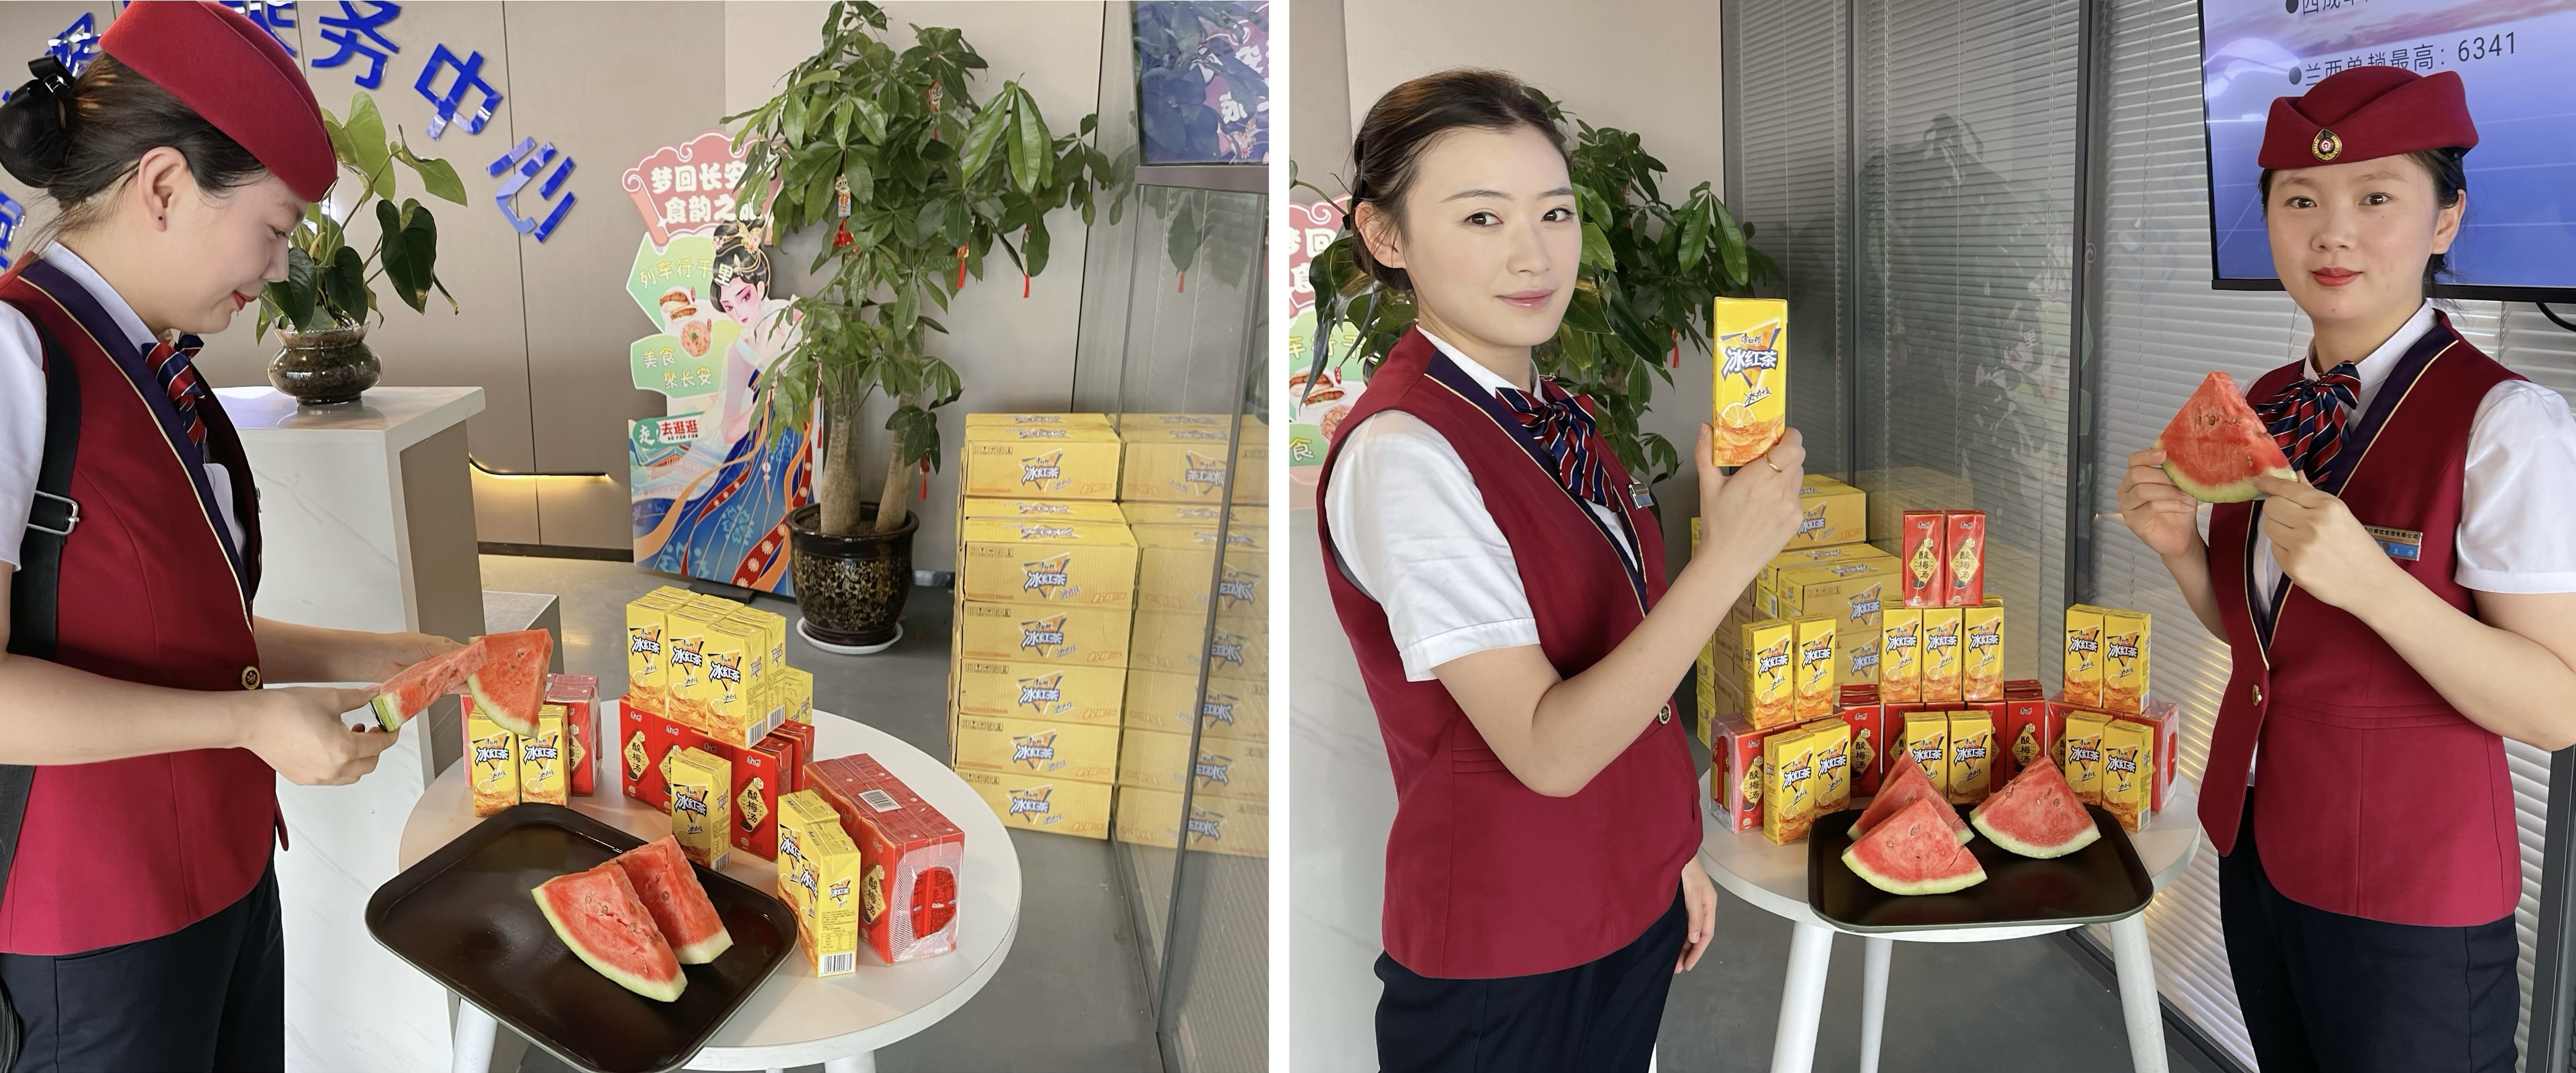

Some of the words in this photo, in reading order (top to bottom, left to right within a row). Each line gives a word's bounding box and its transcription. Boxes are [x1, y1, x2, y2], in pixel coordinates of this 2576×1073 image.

[651, 160, 748, 194] 梦回长安
[643, 346, 676, 369] 美食
[1722, 347, 1777, 380] 冰红茶
[663, 366, 713, 389] 聚长安
[661, 419, 698, 436] 去逛逛
[2364, 527, 2418, 540] 行餐饮管理有限公司
[1918, 551, 1929, 579] 酸梅汤
[631, 635, 661, 655] 冰红茶
[1886, 635, 1918, 655] 冰红茶
[1927, 635, 1958, 654] 冰红茶
[1968, 634, 2000, 654] 冰红茶
[2068, 636, 2098, 656] 冰红茶
[2107, 642, 2138, 662] 冰红茶
[671, 646, 703, 668] 冰红茶
[1758, 654, 1789, 679] 冰红茶
[1802, 647, 1832, 676] 冰红茶
[709, 661, 741, 684] 冰红茶
[475, 747, 510, 767] 冰红茶
[523, 745, 558, 765] 冰红茶
[632, 742, 642, 773] 酸梅汤
[1855, 741, 1867, 769] 酸梅汤
[1913, 748, 1943, 764] 冰红茶
[1954, 747, 1987, 768] 冰红茶
[2069, 745, 2100, 765] 冰红茶
[2106, 755, 2137, 776] 冰红茶
[1818, 754, 1847, 781] 冰红茶
[1749, 770, 1760, 800] 酸梅汤
[1782, 767, 1812, 794] 冰红茶
[674, 791, 707, 818] 冰红茶
[747, 788, 759, 823] 酸梅汤
